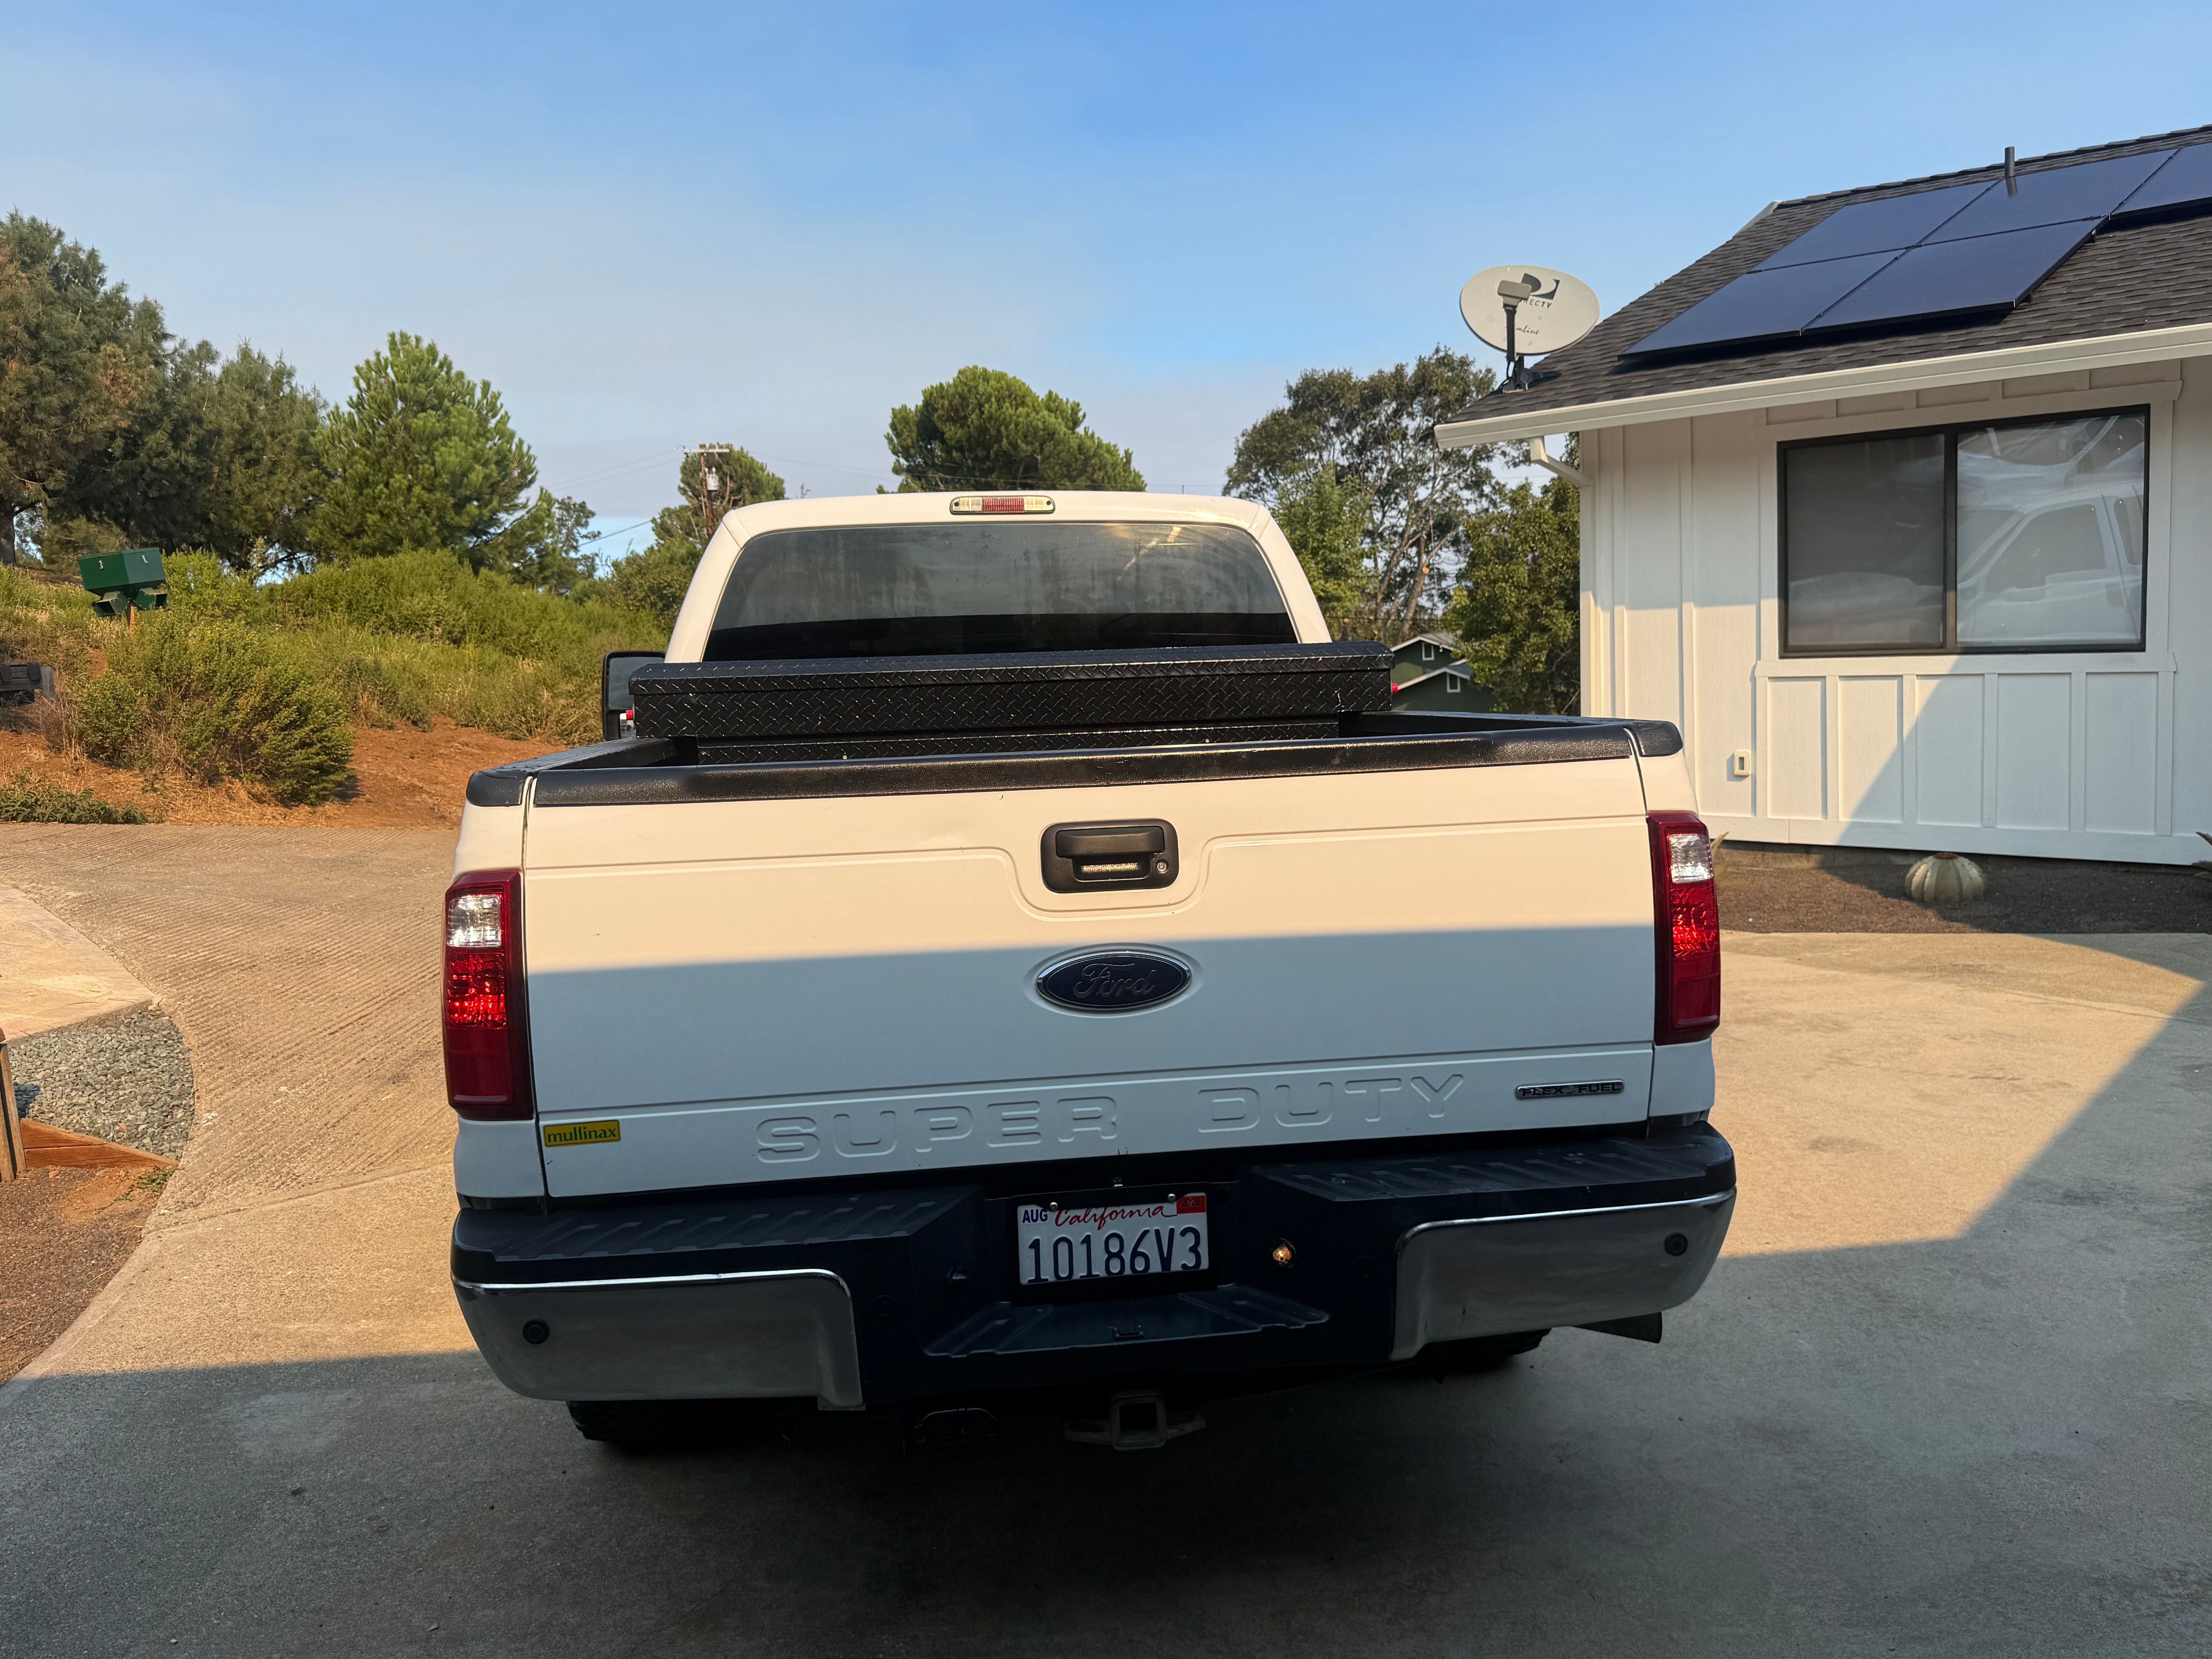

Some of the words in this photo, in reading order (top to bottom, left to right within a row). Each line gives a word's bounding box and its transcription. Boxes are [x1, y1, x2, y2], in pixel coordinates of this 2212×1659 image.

[1073, 963, 1156, 998] Ford
[1522, 1086, 1564, 1096] FLEX
[1578, 1083, 1621, 1093] FUEL
[756, 1096, 1117, 1163] SUPER
[1198, 1073, 1464, 1133] DUTY
[548, 1127, 617, 1142] mullinax
[1182, 1198, 1200, 1206] 2026
[1022, 1209, 1048, 1223] AUG
[1054, 1205, 1178, 1230] California
[1027, 1226, 1201, 1284] 10186V3
